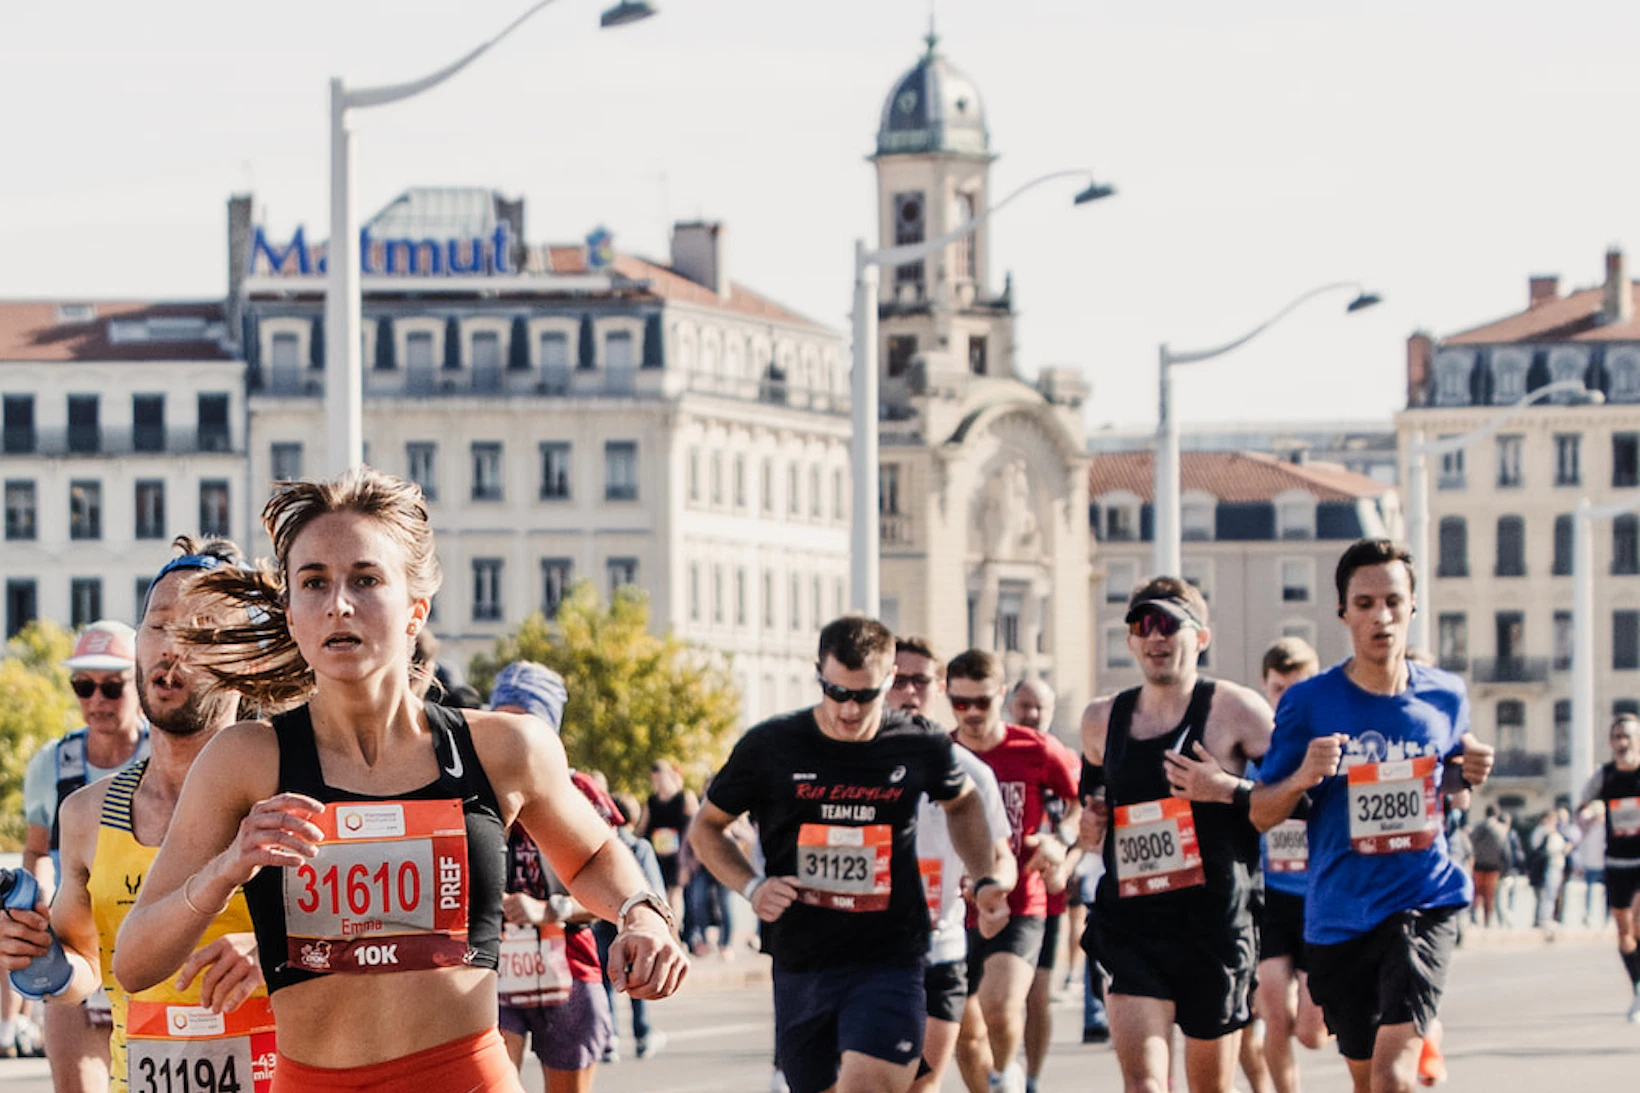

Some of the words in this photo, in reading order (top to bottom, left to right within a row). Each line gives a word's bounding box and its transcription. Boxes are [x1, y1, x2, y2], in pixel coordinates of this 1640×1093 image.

[821, 804, 852, 820] TEAM
[1358, 791, 1420, 821] 32880
[1120, 831, 1175, 863] 30808
[806, 853, 868, 880] 31123
[297, 860, 421, 915] 31610
[439, 856, 461, 910] PREF
[341, 918, 383, 935] Emma
[354, 943, 398, 966] 10K
[498, 953, 546, 977] 7608
[250, 1052, 277, 1070] -43
